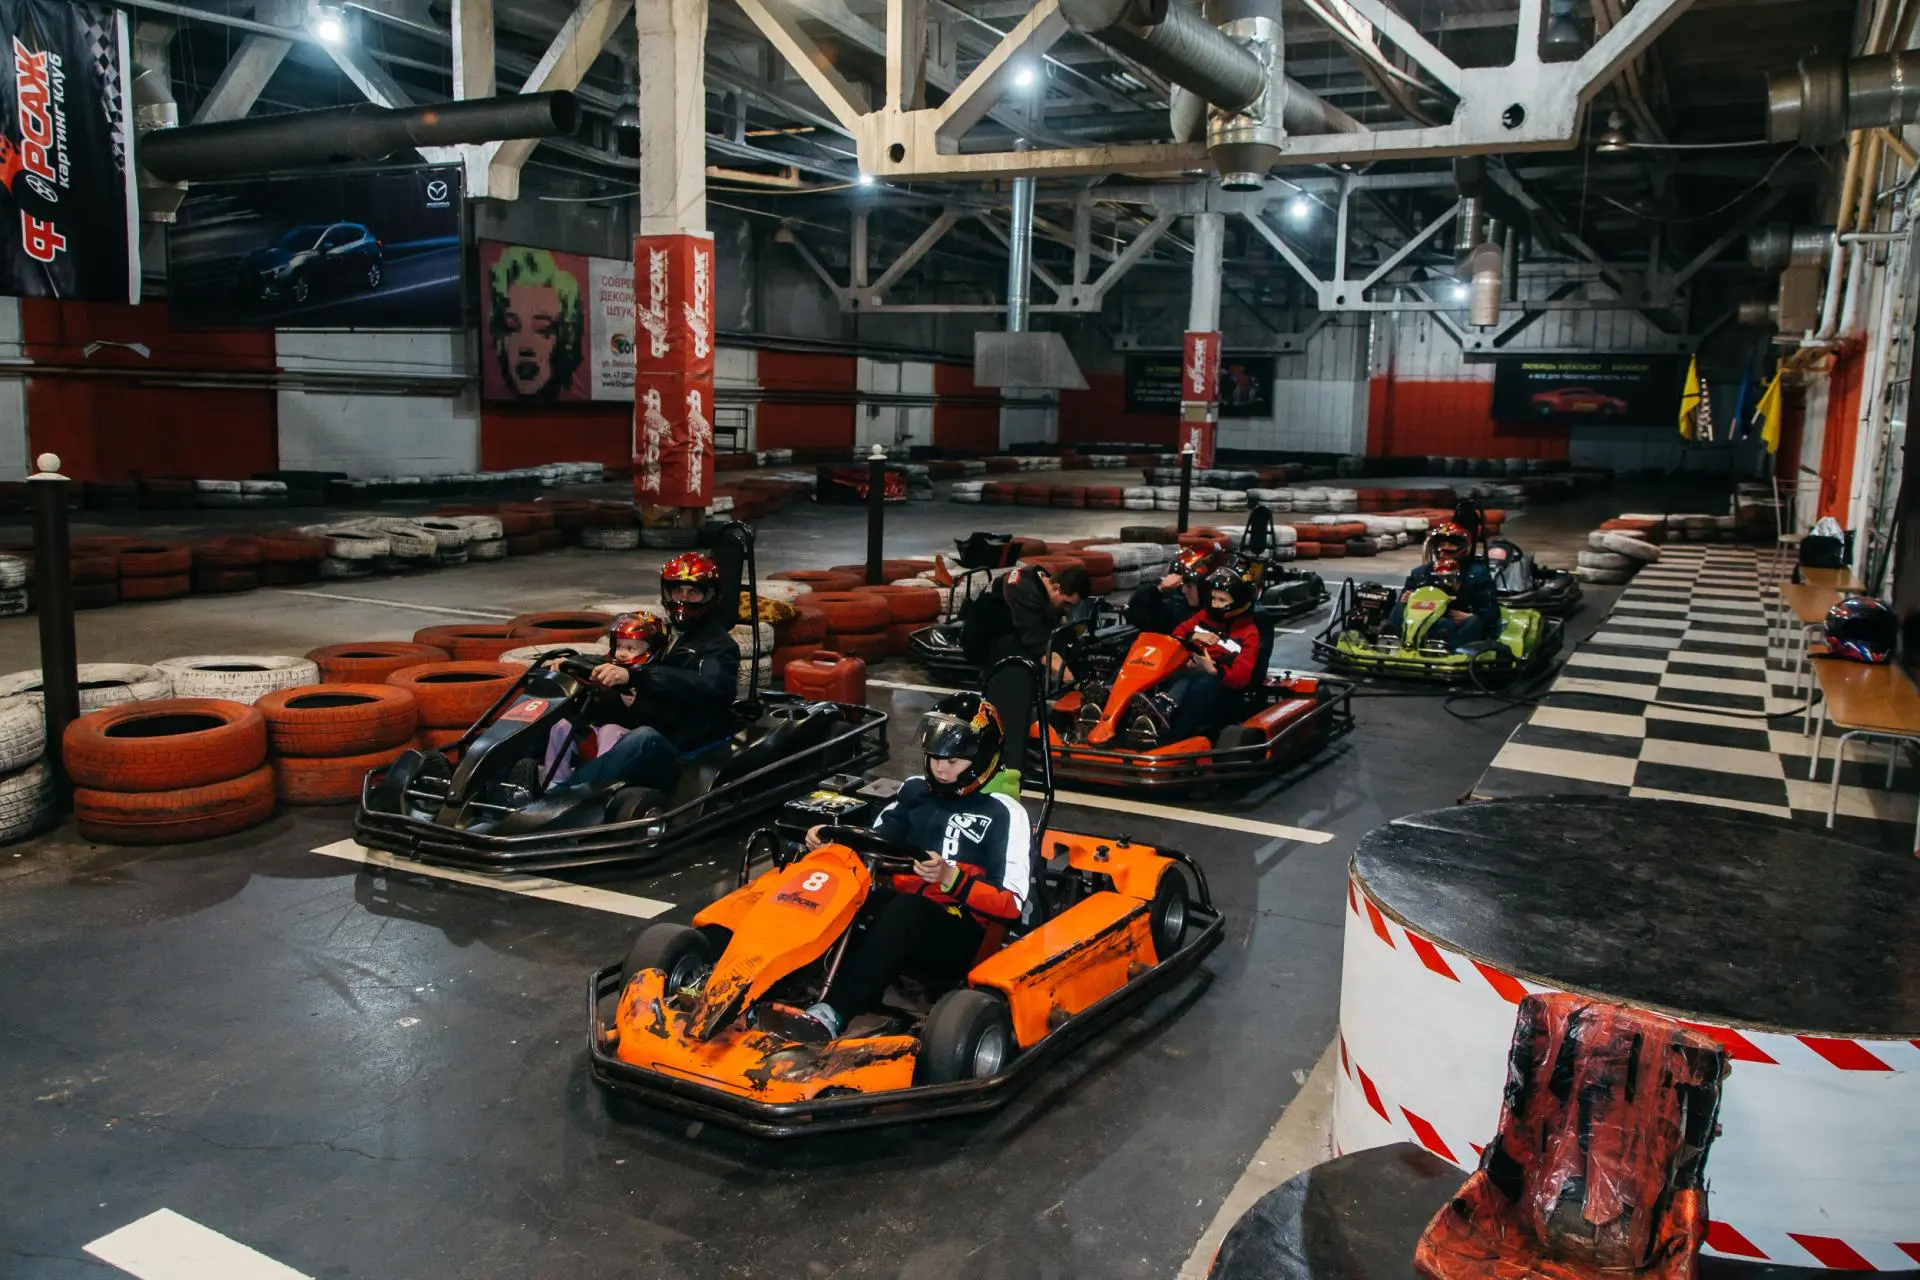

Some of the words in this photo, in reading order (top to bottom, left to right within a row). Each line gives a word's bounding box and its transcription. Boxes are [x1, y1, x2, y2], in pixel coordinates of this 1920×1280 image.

[48, 52, 66, 103] клуб
[54, 103, 71, 189] картинг
[606, 305, 634, 317] ШТУК
[1144, 646, 1157, 657] 7
[524, 700, 543, 711] 6
[802, 871, 829, 891] 8
